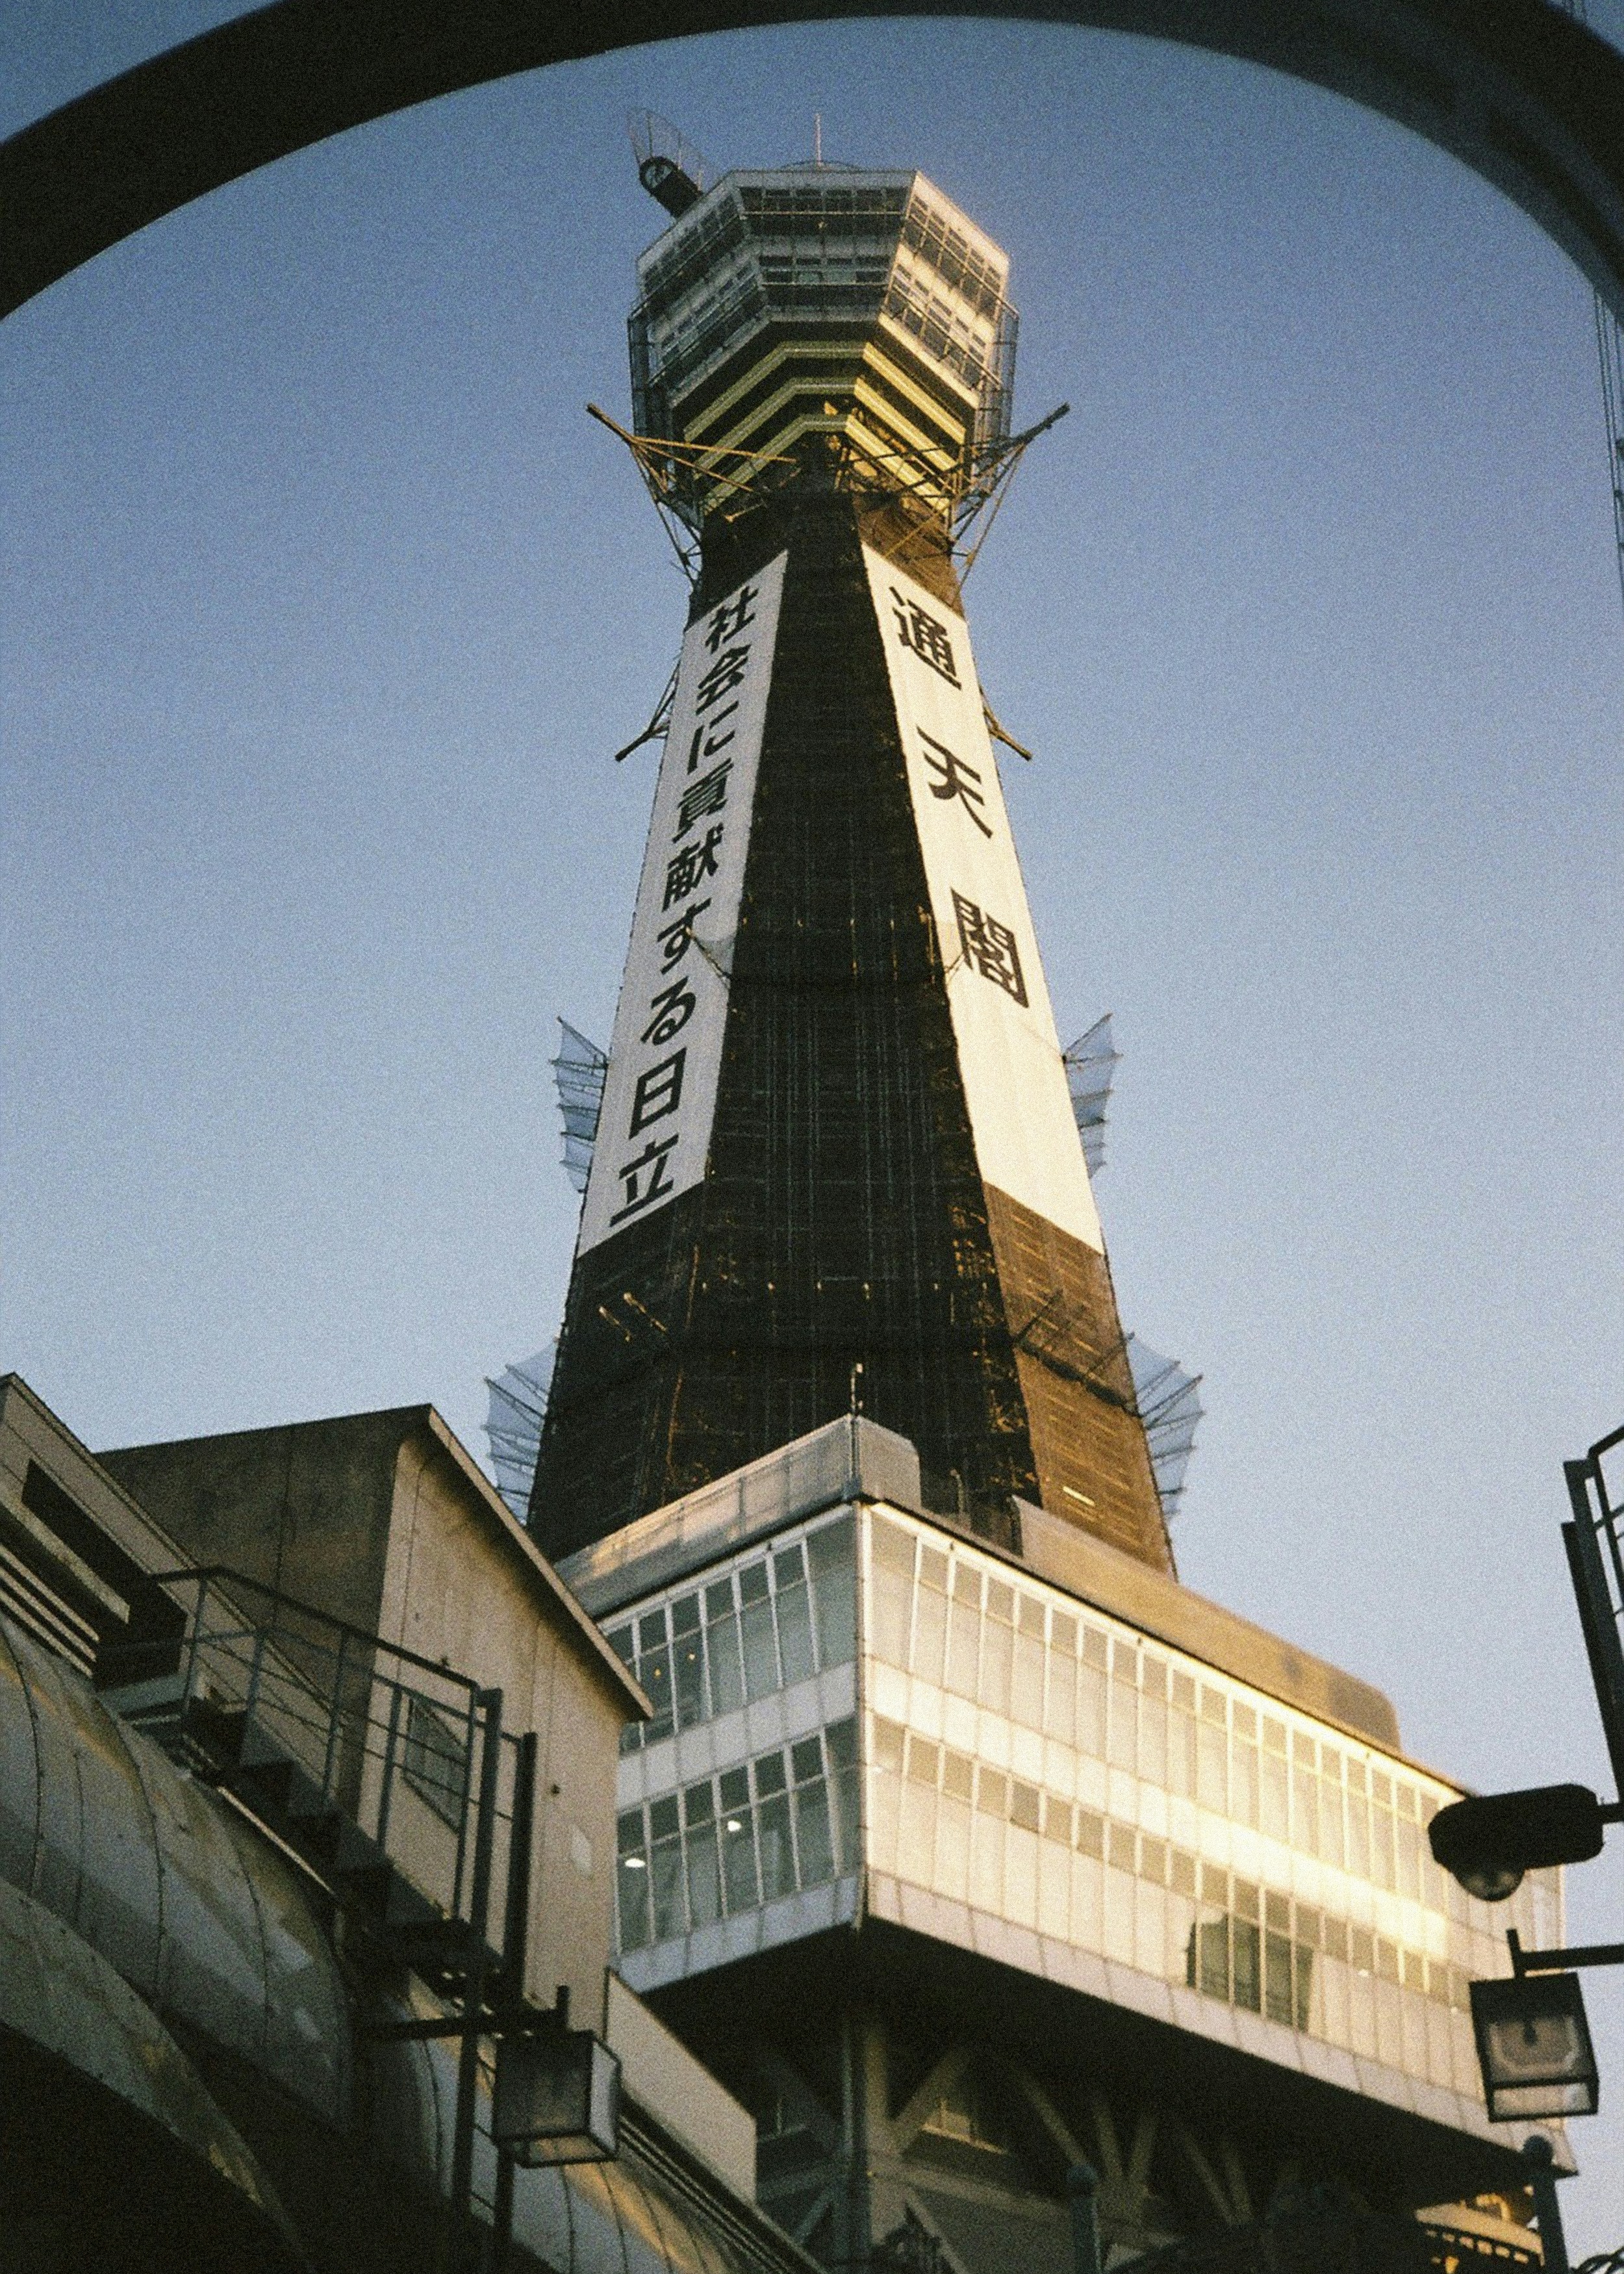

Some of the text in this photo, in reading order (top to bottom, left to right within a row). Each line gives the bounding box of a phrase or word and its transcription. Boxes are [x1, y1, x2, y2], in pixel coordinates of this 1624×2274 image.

[610, 586, 759, 1227] 社会に貢献する日立
[889, 586, 1029, 1008] 通天閣
